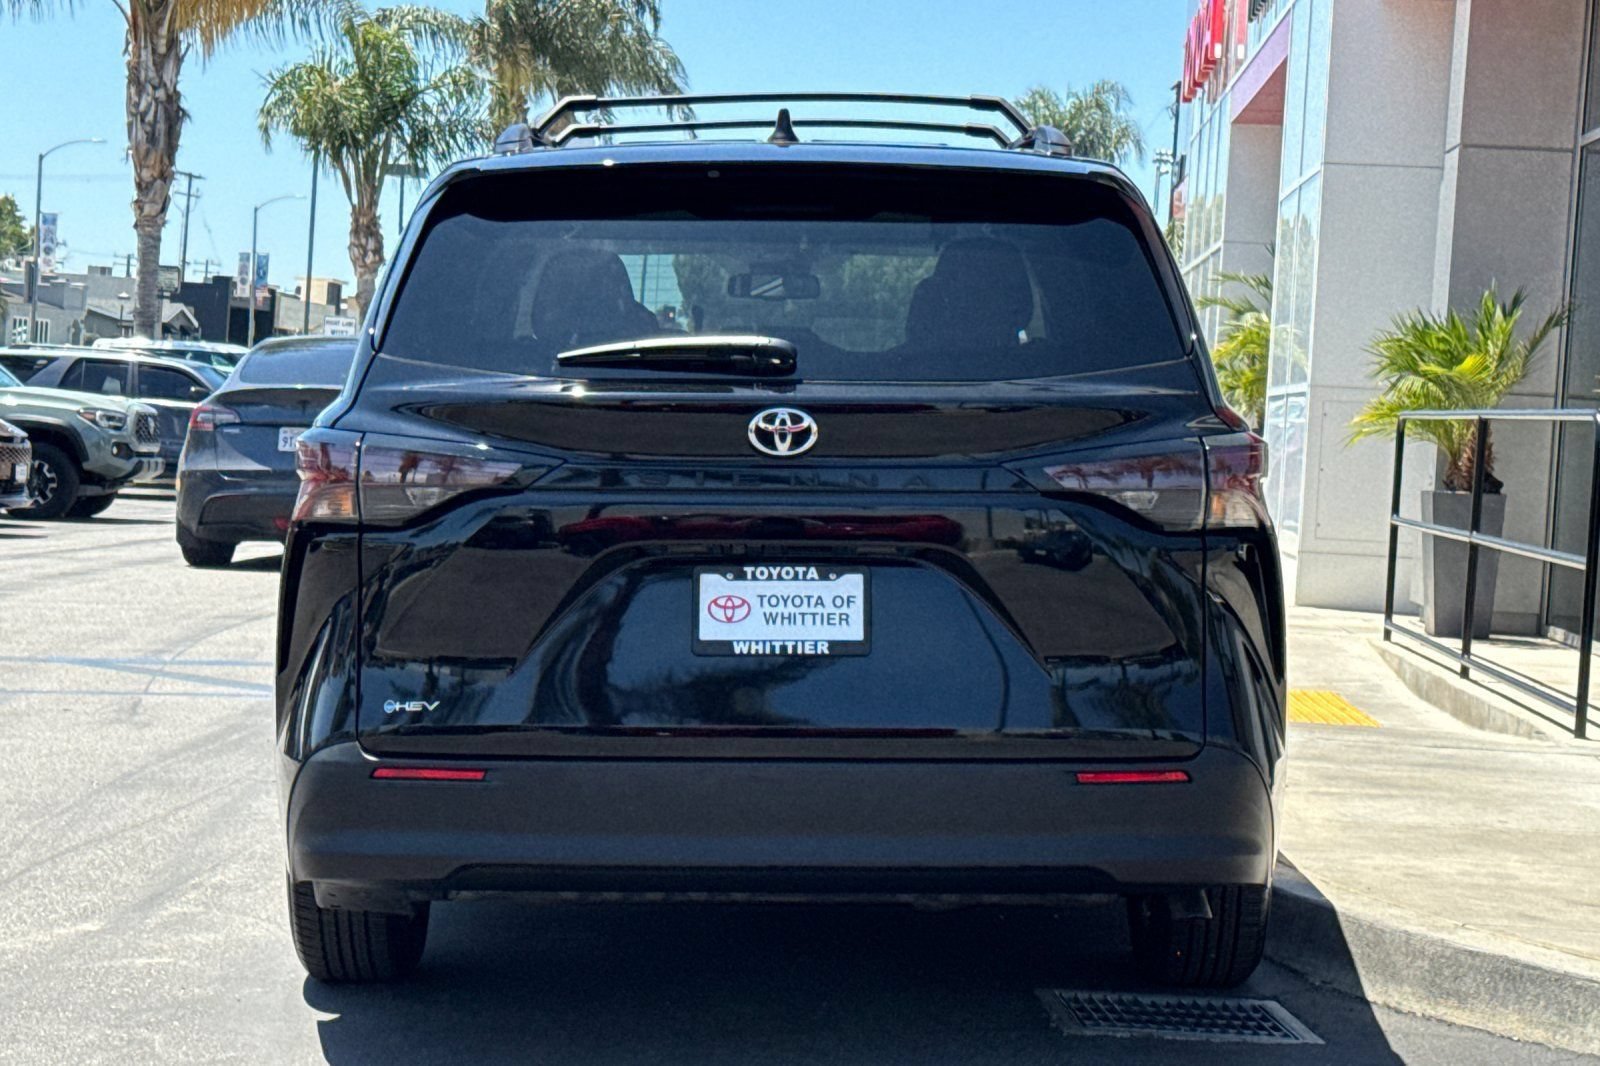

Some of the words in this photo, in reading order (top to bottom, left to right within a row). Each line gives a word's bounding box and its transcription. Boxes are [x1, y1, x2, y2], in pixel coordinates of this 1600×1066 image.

[743, 566, 819, 580] TOYOTA
[757, 594, 826, 609] TOYOTA
[832, 595, 857, 609] OF
[763, 612, 850, 626] WHITTIER
[732, 641, 830, 655] WHITTIER
